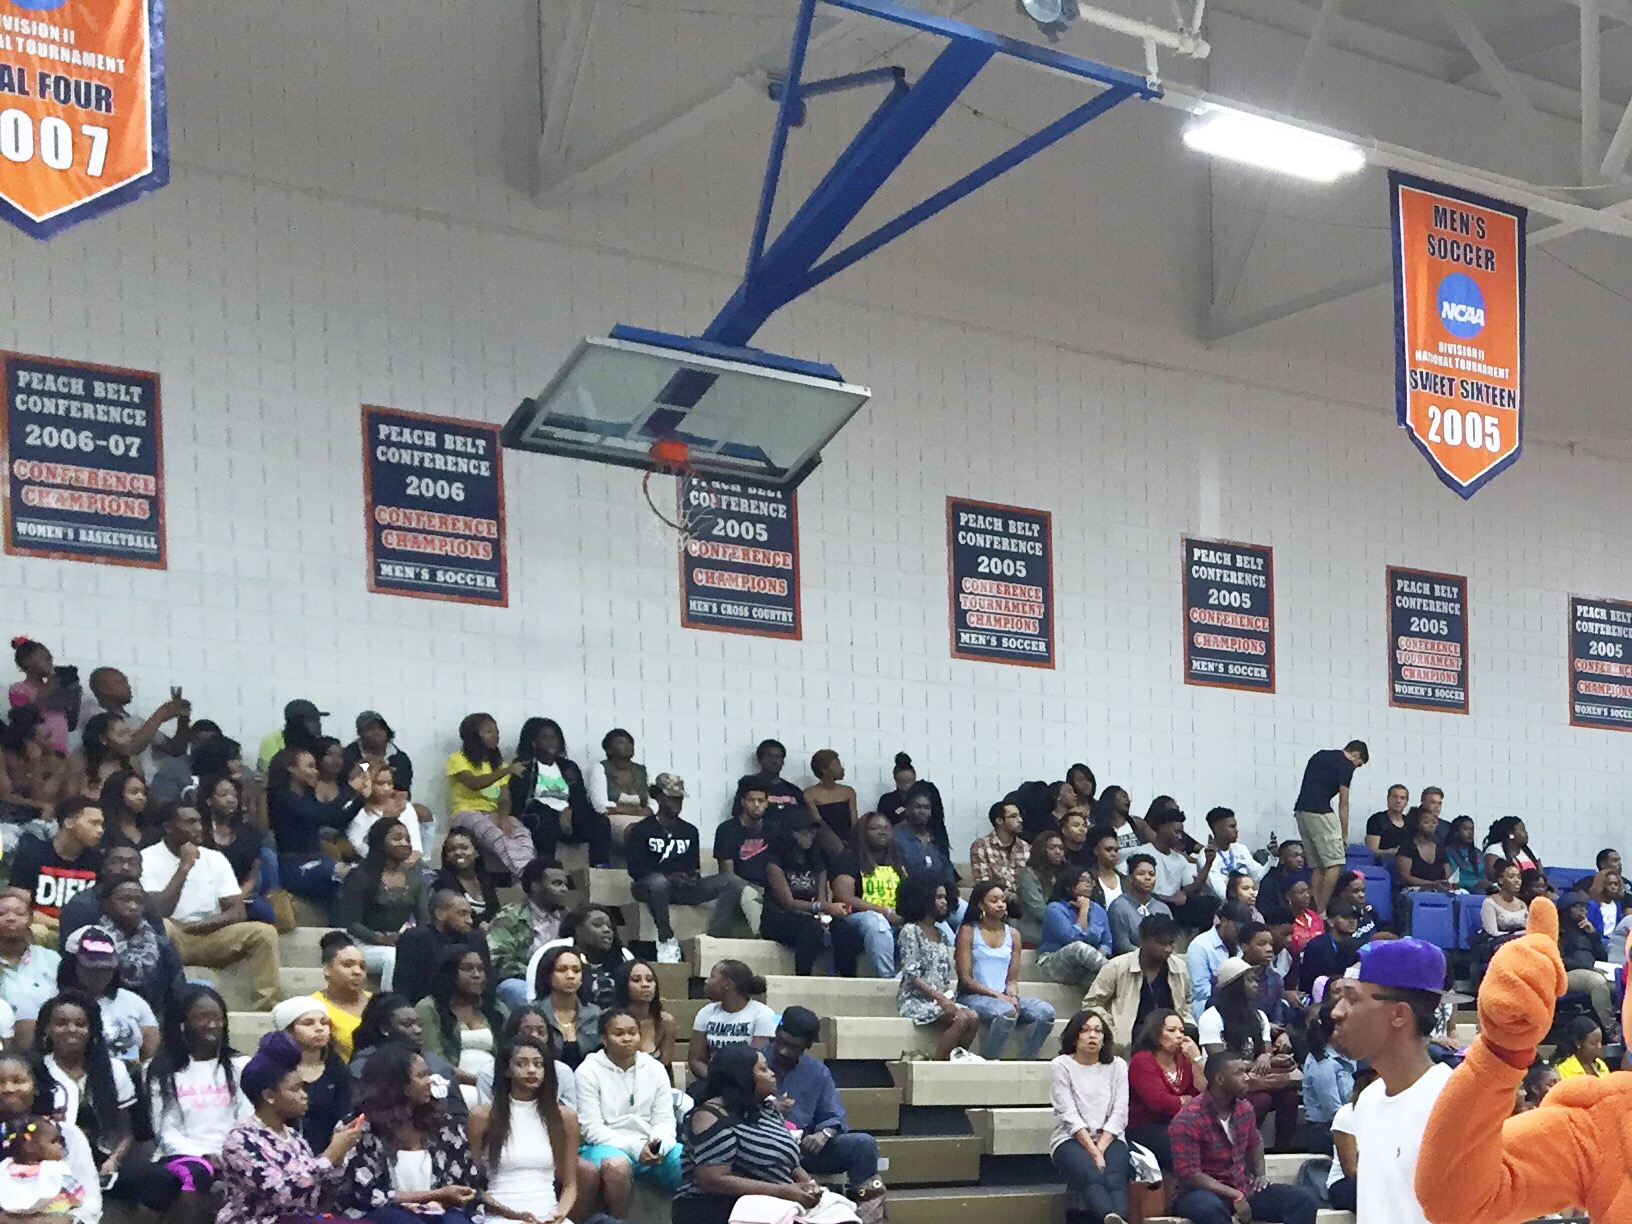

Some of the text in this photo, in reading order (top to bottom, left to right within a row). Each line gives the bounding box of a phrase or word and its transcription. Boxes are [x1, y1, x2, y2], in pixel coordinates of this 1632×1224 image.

[16, 36, 125, 74] TOURNAMENT
[38, 70, 114, 115] FOUR
[1433, 205, 1486, 240] MEN'S
[1427, 233, 1496, 272] SOCCER
[1442, 301, 1485, 326] NCAA
[1439, 341, 1477, 359] DIVISION
[1415, 350, 1509, 379] NATIONAL TOURNAMENT
[16, 370, 143, 403] PEACH BELT
[1409, 369, 1517, 409] SWEET SIXTEEN
[15, 394, 147, 427] CONFERENCE
[25, 424, 142, 458] 2006-07
[377, 424, 487, 455] PEACH BELT
[1428, 405, 1501, 452] 2005
[376, 445, 491, 477] CONFERENCE
[13, 459, 156, 496] CONFERENCE
[405, 475, 465, 502] 2006
[21, 484, 150, 519] CHAMPIONS
[689, 490, 787, 519] CONFERENCE
[374, 505, 498, 538] CONFERENCE
[712, 517, 768, 542] 2005
[959, 512, 1041, 538] PEACH BELT
[16, 521, 158, 550] WOMEN'S BASKETBALL
[381, 529, 493, 560] CHAMPIONS
[958, 531, 1043, 557] CONFERENCE
[687, 539, 792, 570] CONFERENCE
[977, 556, 1027, 578] 2005
[1193, 548, 1264, 571] PEACH BELT
[380, 563, 496, 588] MEN'S SOCCER
[693, 568, 788, 596] CHAMPIONS
[1191, 565, 1266, 589] CONFERENCE
[962, 577, 1043, 601] CONFERENCE
[1208, 588, 1252, 609] 2005
[1396, 579, 1459, 599] PEACH BELT
[689, 600, 794, 622] MEN'S CROSS COUNTRY
[959, 593, 1045, 619] TOURNAMENT
[1395, 596, 1461, 616] CONFERENCE
[1576, 605, 1632, 624] PEACH BELT
[966, 611, 1039, 634] CHAMPIONS
[1189, 607, 1269, 633] CONFERENCE
[1410, 616, 1448, 636] 2005
[960, 632, 1047, 652] MEN'S SOCCER
[1194, 632, 1266, 655] CHAMPIONS
[1398, 635, 1460, 656] CONFERENCE
[1589, 640, 1623, 658] 2005
[1192, 659, 1267, 678] MEN'S SOCCER
[1396, 650, 1462, 671] TOURNAMENT
[1401, 666, 1458, 685] CHAMPIONS
[1394, 684, 1465, 701] WOMEN'S SOCCER
